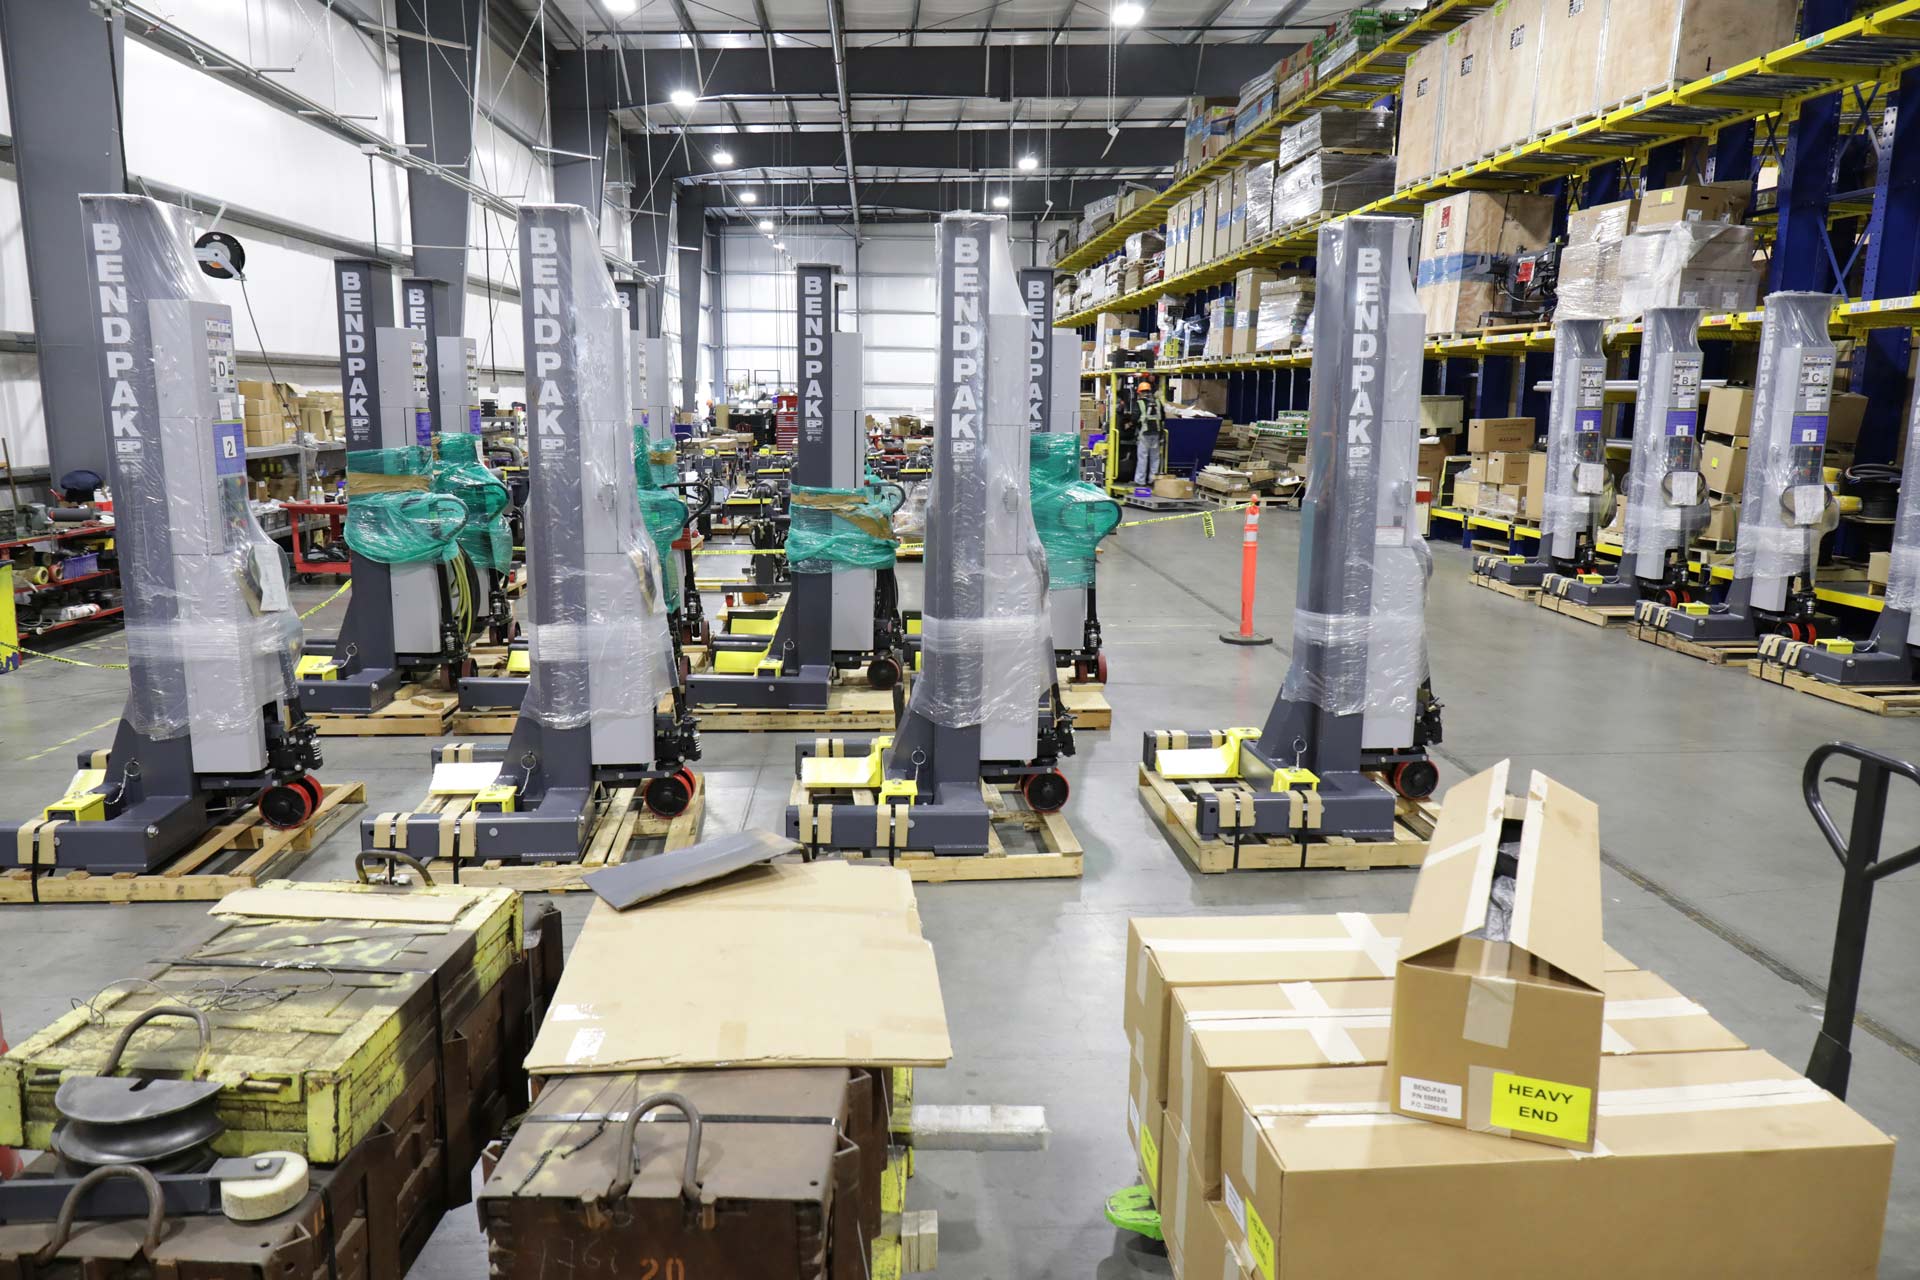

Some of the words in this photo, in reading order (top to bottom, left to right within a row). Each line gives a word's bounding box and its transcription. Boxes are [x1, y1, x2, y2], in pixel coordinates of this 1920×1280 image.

[92, 223, 142, 437] BENDPAK
[530, 227, 566, 435] BENDPAK
[951, 237, 980, 439] BENDPAK
[341, 271, 369, 416] BENDPAK
[804, 276, 824, 418] BENDPAK
[1347, 247, 1382, 444] BENDPAK
[218, 361, 226, 377] D
[1588, 377, 1595, 387] A
[1682, 377, 1689, 385] B
[1811, 373, 1820, 383] C
[351, 418, 369, 427] BP
[806, 419, 823, 428] BP
[226, 440, 234, 456] 2
[1508, 1083, 1574, 1105] HEAVY
[1519, 1106, 1559, 1123] END
